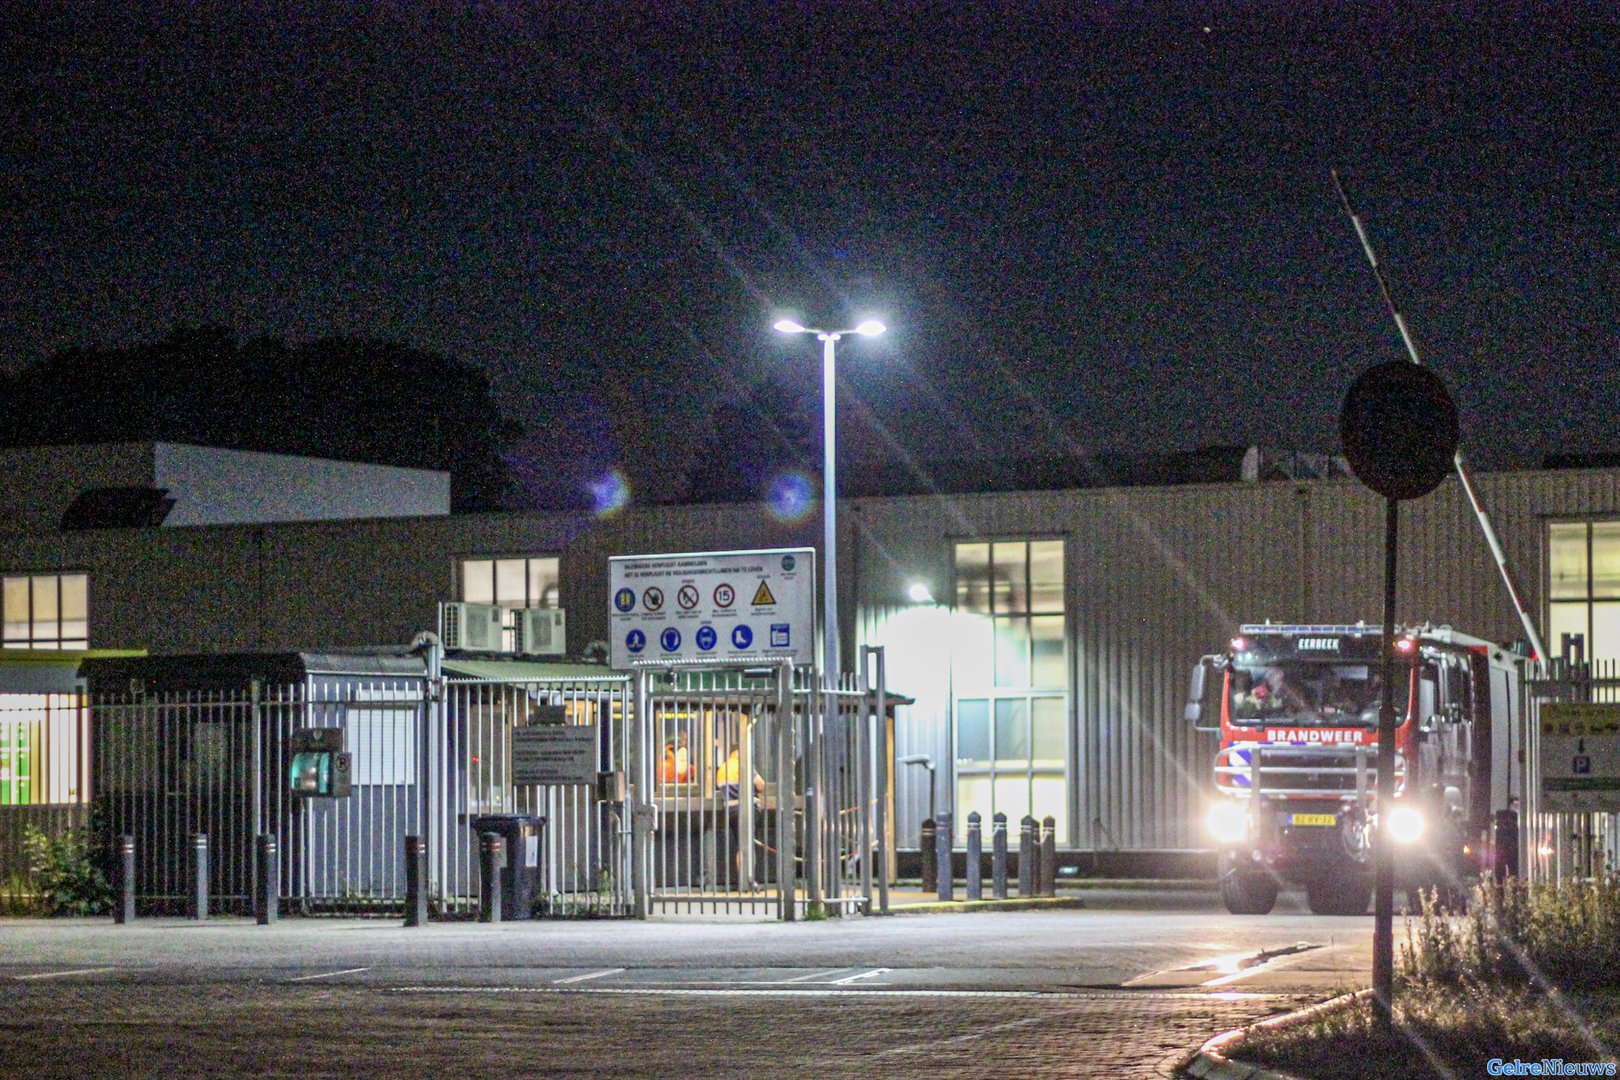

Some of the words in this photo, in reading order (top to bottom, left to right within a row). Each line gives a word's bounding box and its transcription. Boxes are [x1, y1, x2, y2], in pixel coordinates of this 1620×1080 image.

[718, 590, 730, 601] 15
[1298, 638, 1339, 650] EERBEEK
[1267, 729, 1363, 743] BRANDWEER
